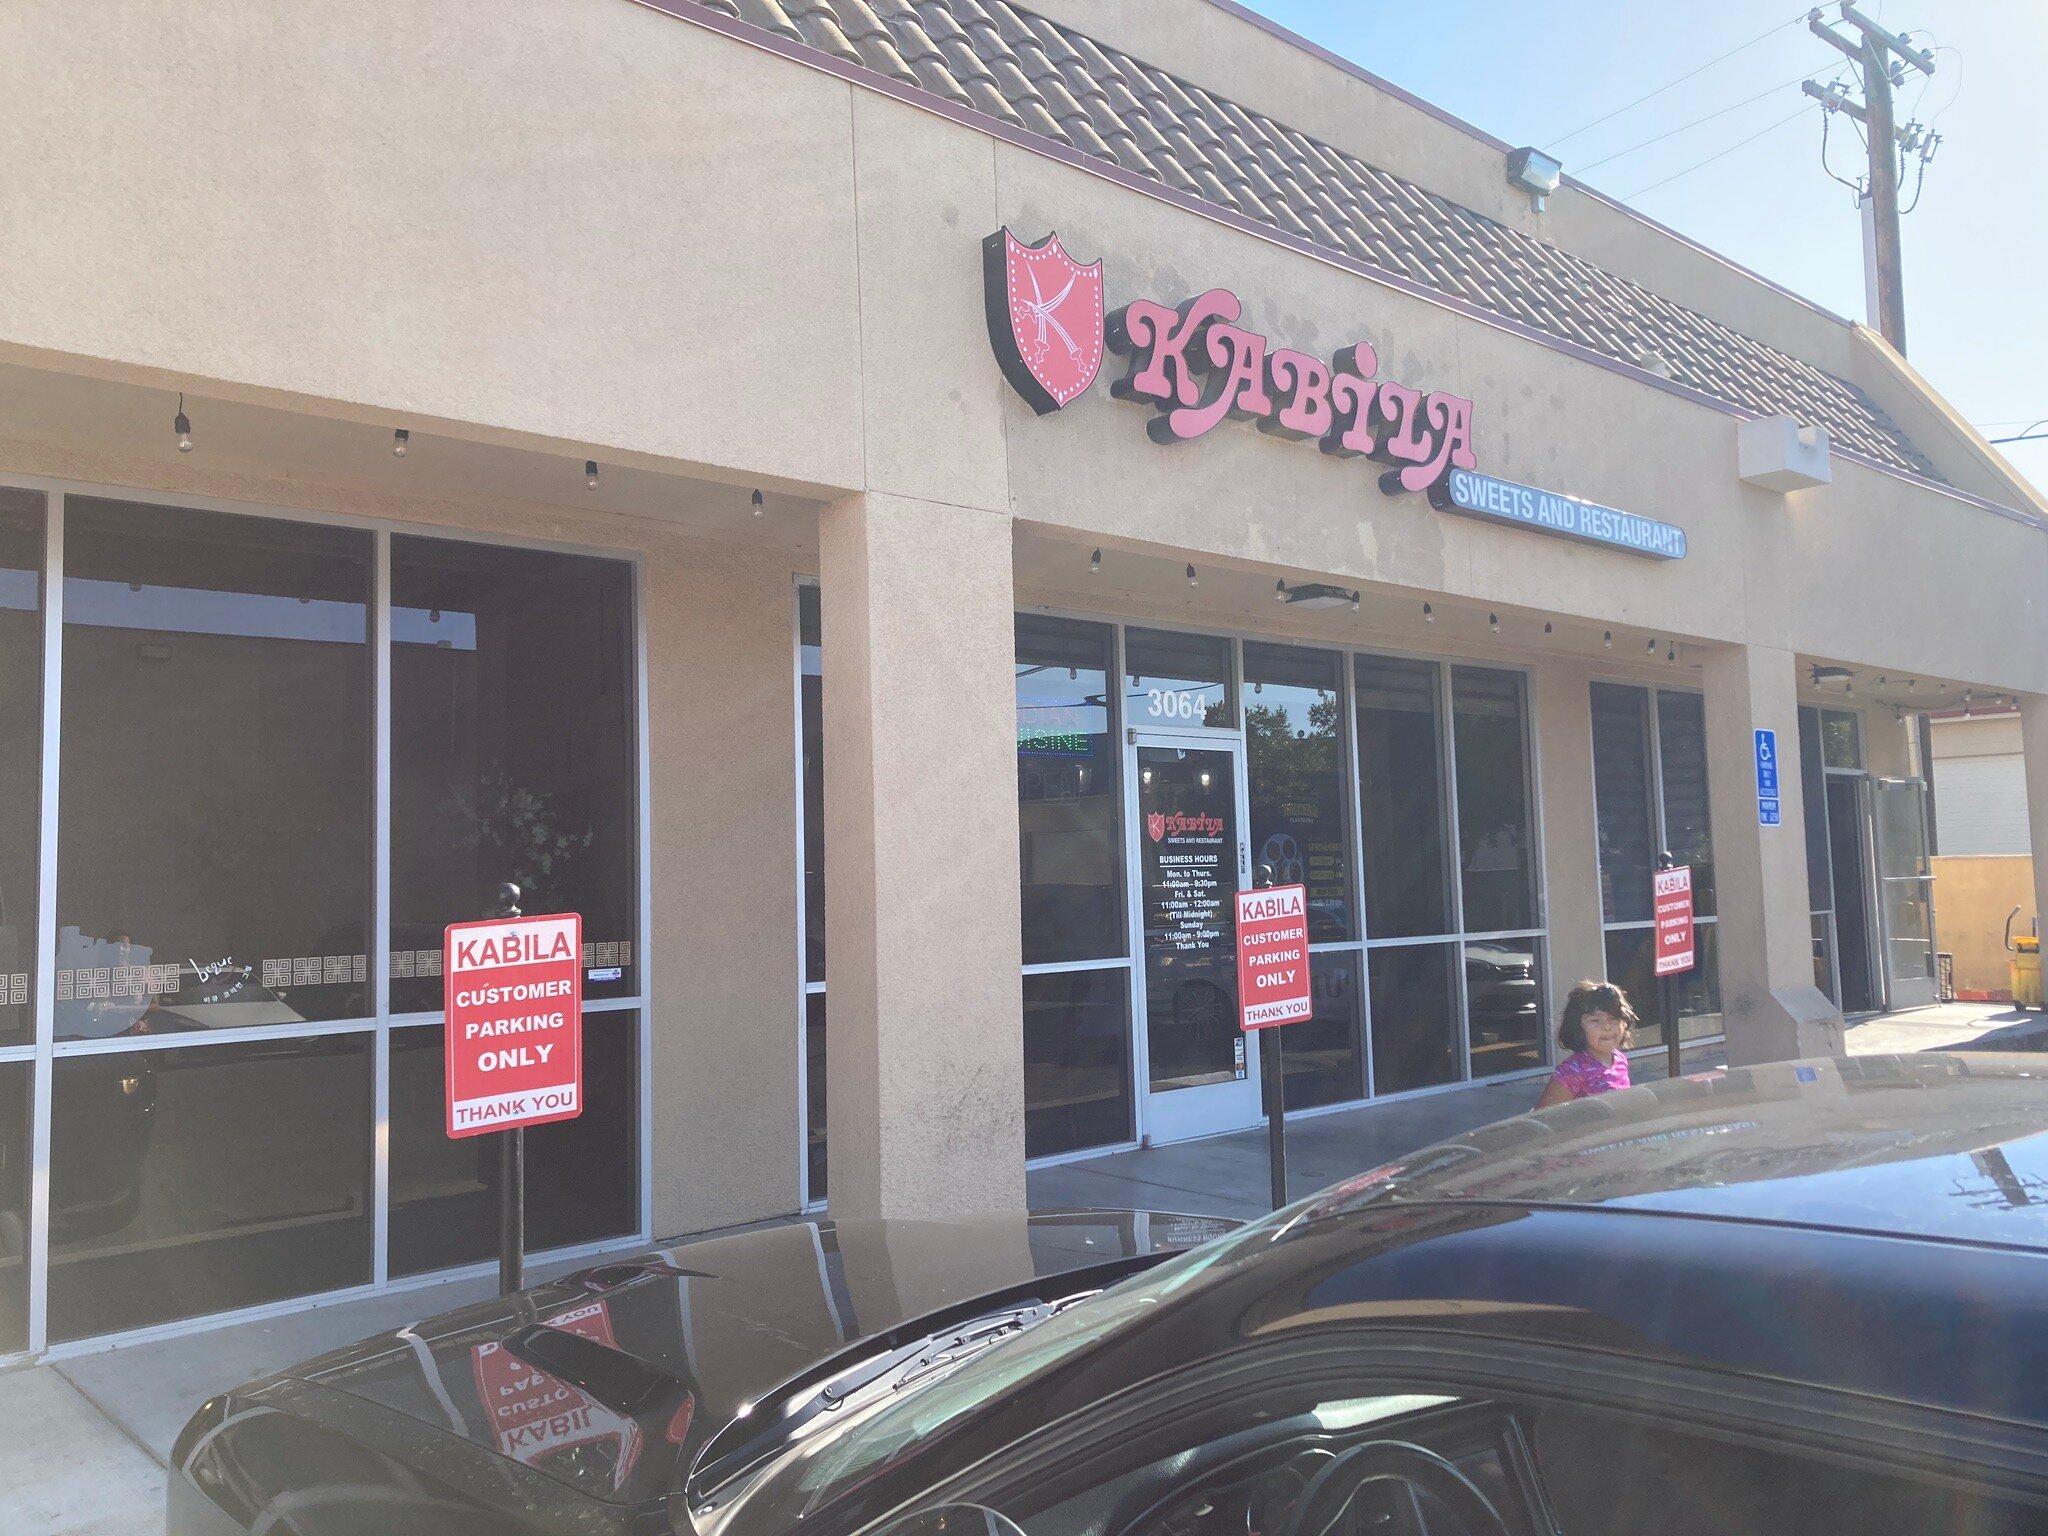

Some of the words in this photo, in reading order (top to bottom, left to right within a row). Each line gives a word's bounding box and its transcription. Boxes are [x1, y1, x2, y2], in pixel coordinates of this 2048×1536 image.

[1455, 473, 1534, 520] SWEETS
[1538, 496, 1575, 529] AND
[1580, 506, 1683, 555] RESTAURANT
[1148, 688, 1207, 727] 3064
[1160, 855, 1193, 863] BUSINESS
[1195, 855, 1218, 863] HOURS
[1167, 870, 1182, 878] Mon.
[1192, 869, 1212, 877] Thurs.
[1194, 880, 1217, 888] 9:30pm
[1658, 876, 1689, 894] KABILA
[1174, 890, 1185, 898] Fri.
[1186, 890, 1192, 898] &
[1161, 901, 1188, 909] 11:00am
[1193, 900, 1220, 908] 12:00am
[1242, 896, 1302, 921] KABILA
[1658, 899, 1690, 914] CUSTOMER
[1184, 909, 1213, 920] Midnight)
[1661, 916, 1689, 929] PARKING
[1180, 921, 1203, 930] Sunday
[1164, 932, 1191, 940] 11:00am
[1196, 930, 1219, 939] 9:00pm
[1243, 927, 1304, 946] CUSTOMER
[1664, 931, 1687, 946] ONLY
[458, 931, 572, 969] KABILA
[1176, 942, 1196, 950] Thank
[1197, 940, 1209, 948] You
[1249, 949, 1301, 966] PARKING
[1256, 970, 1297, 988] ONLY
[456, 979, 572, 1008] CUSTOMER
[1246, 1006, 1284, 1021] THANK
[1285, 1001, 1308, 1015] YOU
[465, 1012, 564, 1040] PARKING
[477, 1044, 554, 1072] ONLY
[456, 1100, 526, 1123] THANK
[532, 1091, 573, 1111] YOU
